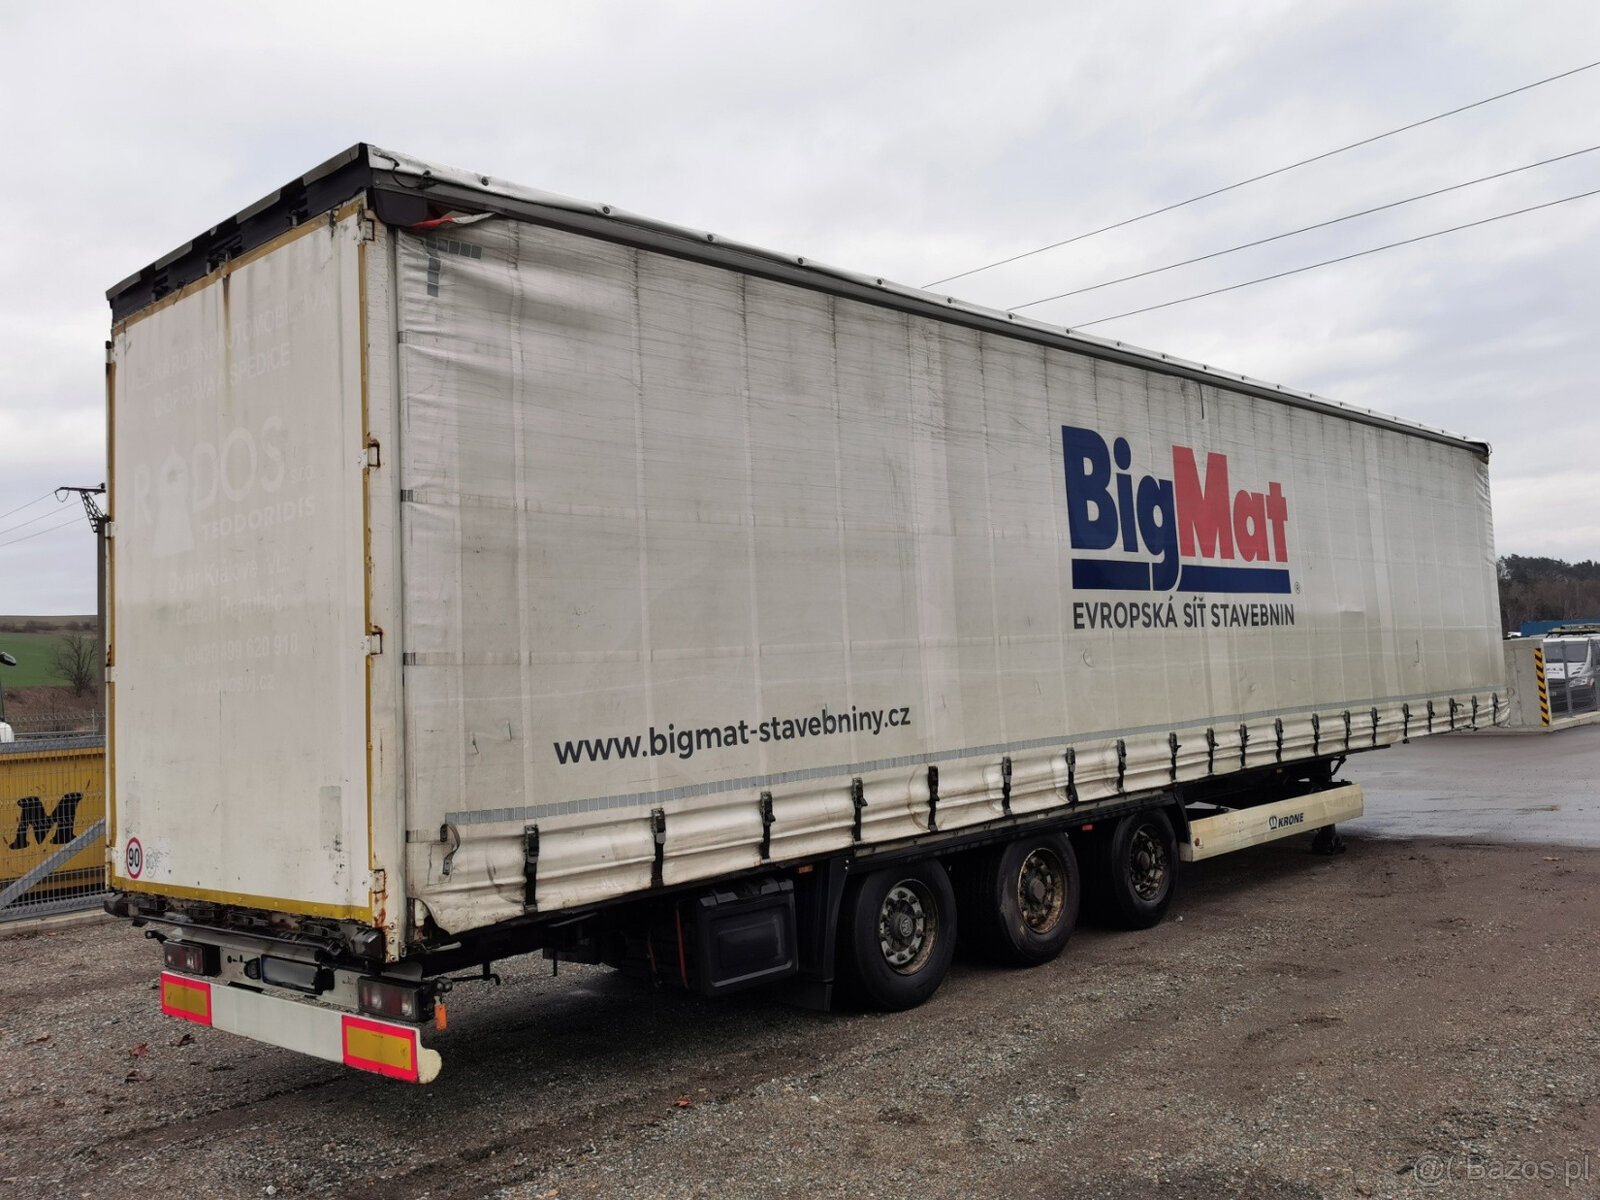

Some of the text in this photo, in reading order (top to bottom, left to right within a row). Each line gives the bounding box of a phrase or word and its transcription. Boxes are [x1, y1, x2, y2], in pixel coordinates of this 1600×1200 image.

[1061, 425, 1288, 591] BigMat
[1073, 595, 1178, 629] EVROPSKÁ
[1211, 603, 1295, 628] STAVEBNIN
[553, 705, 911, 765] www.bigmat-stavebniny.cz
[9, 792, 83, 850] M
[1278, 812, 1304, 828] KRONE
[128, 847, 140, 867] 90
